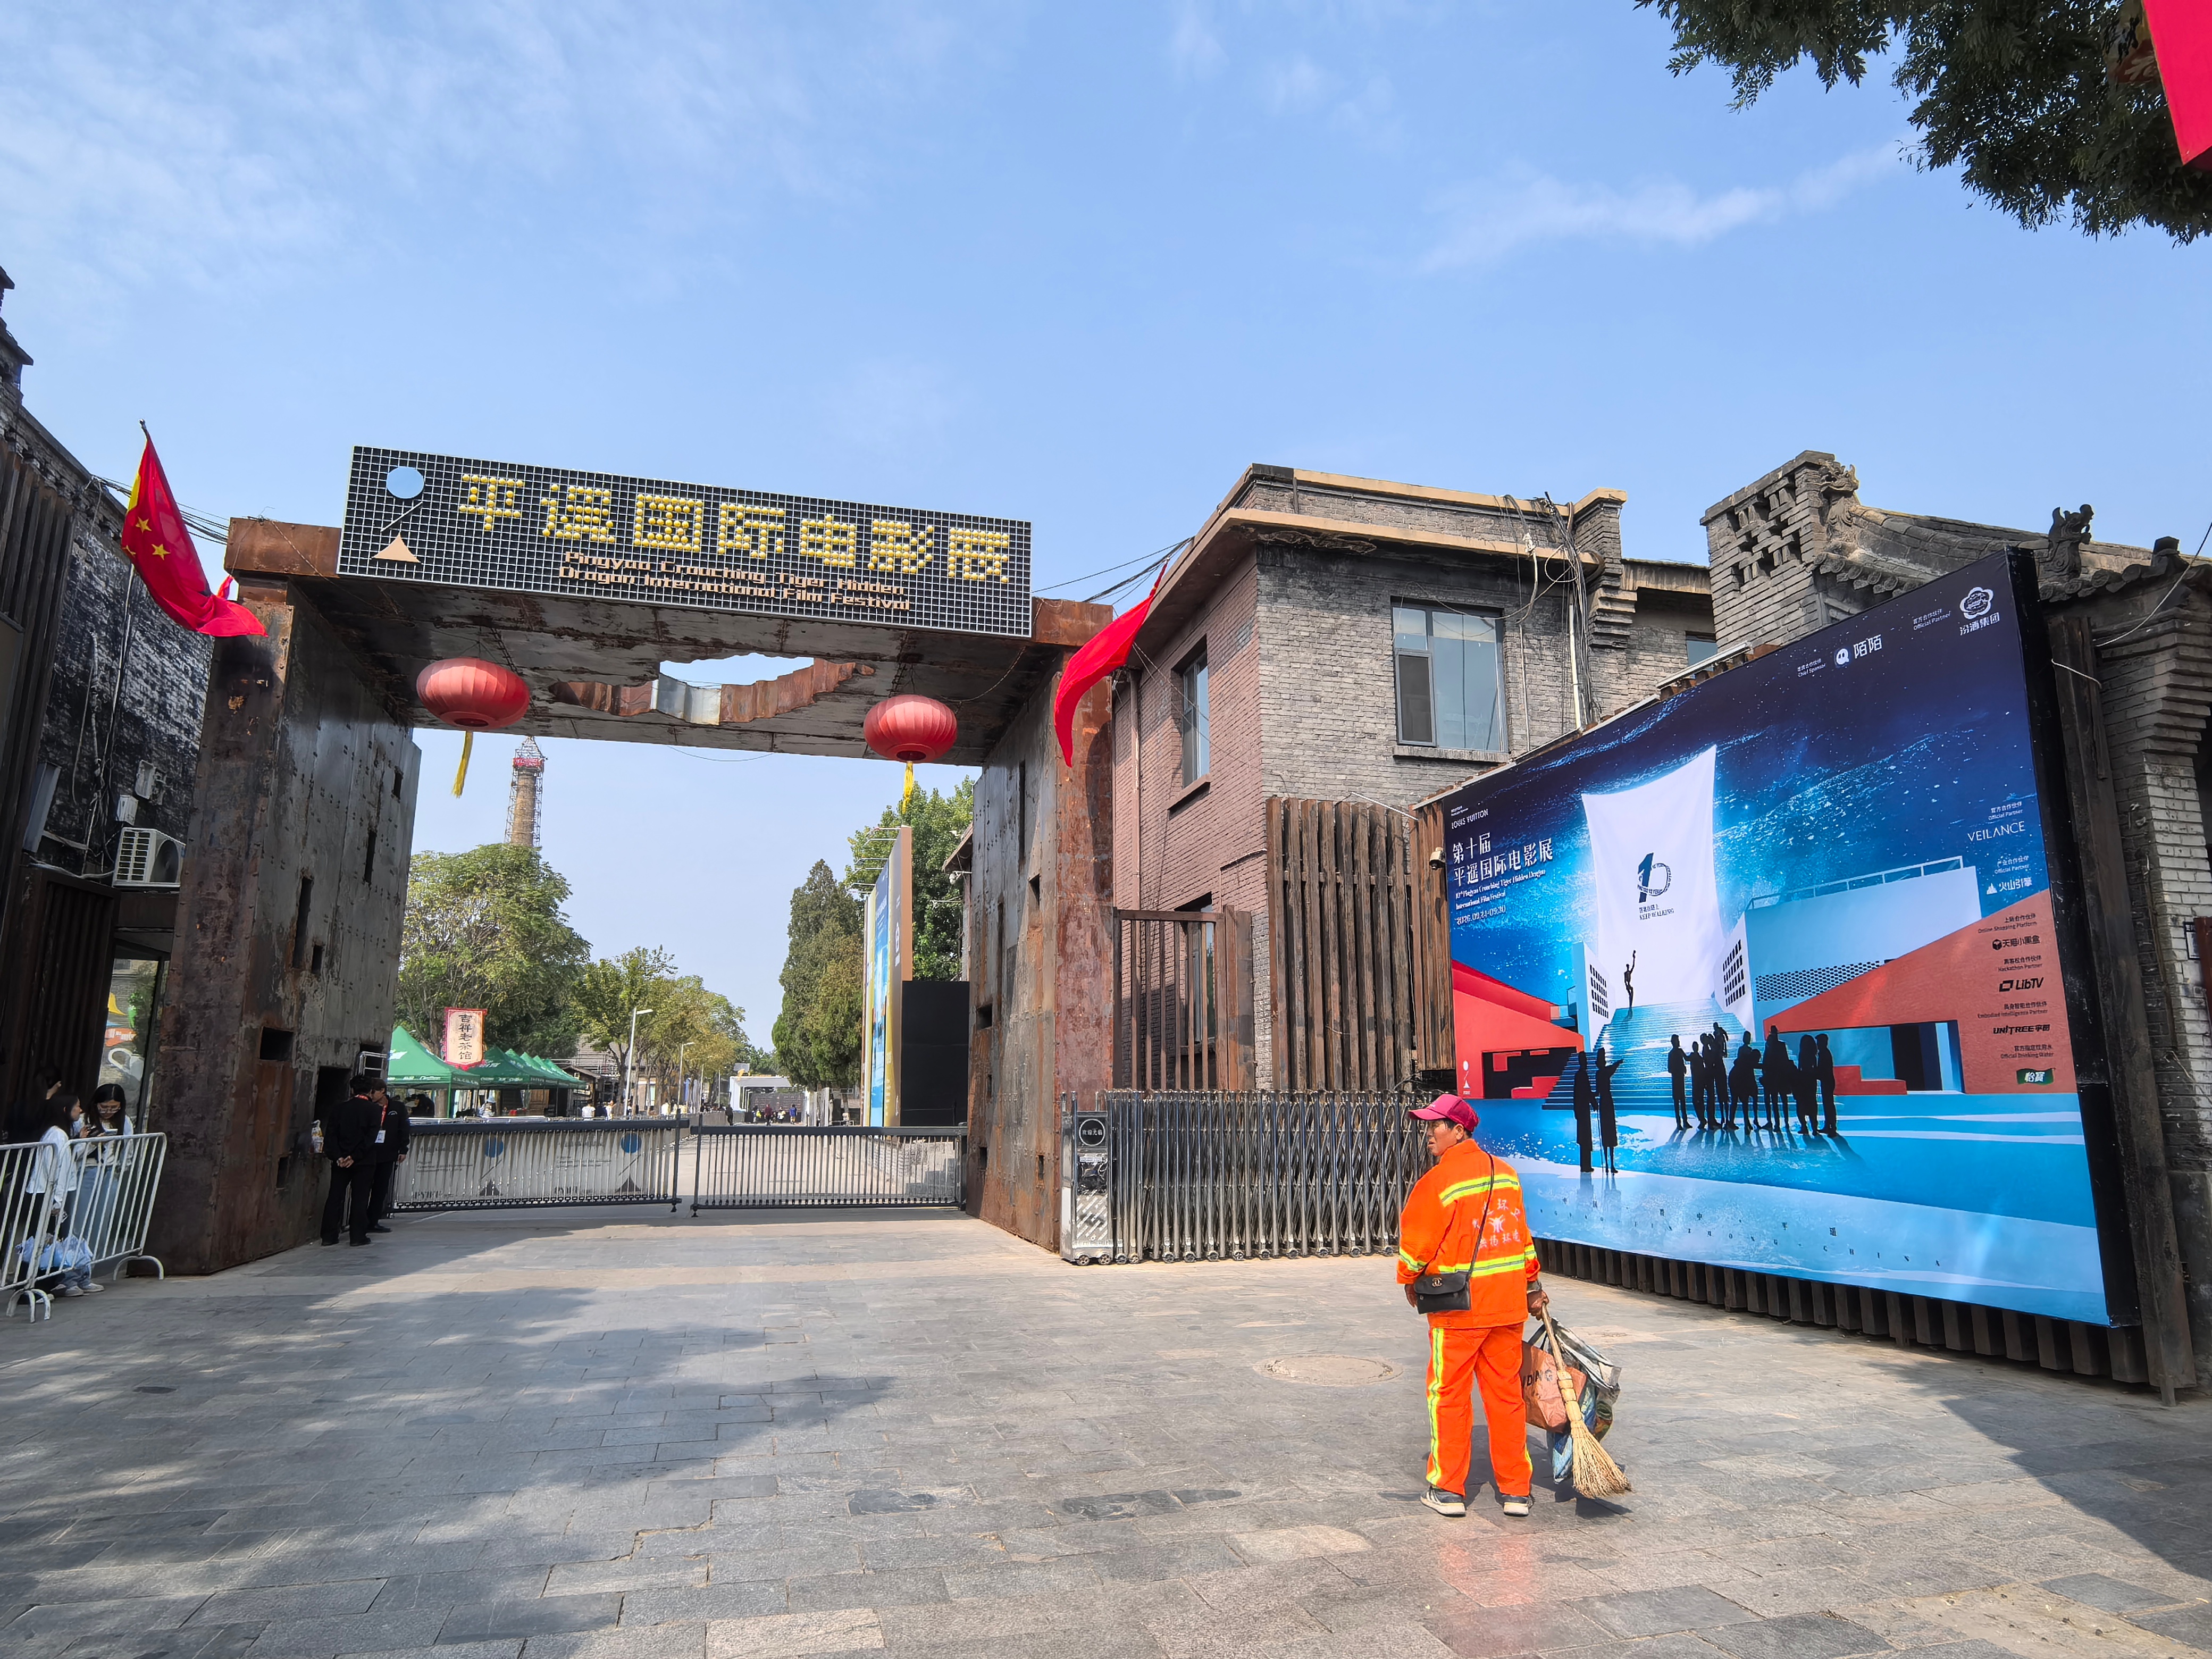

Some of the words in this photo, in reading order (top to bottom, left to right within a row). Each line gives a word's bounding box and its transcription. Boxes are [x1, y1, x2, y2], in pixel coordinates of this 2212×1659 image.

[459, 473, 1010, 584] 平遥国际电影展
[559, 566, 635, 584] Dragon
[644, 574, 775, 598] International
[783, 587, 823, 602] Film
[831, 592, 909, 611] Festival
[661, 560, 765, 584] Crouching
[775, 572, 825, 588] Tiger
[839, 579, 904, 595] Hidden
[1853, 634, 1882, 659] 陌陌
[1451, 817, 1465, 829] LOUIS
[1467, 808, 1488, 823] VUITTON
[1967, 821, 2025, 841] VEILANCE
[1452, 832, 1491, 864] 第十届
[1453, 837, 1553, 887] 平遥国际电影展
[1999, 877, 2032, 892] 火山引擎
[2015, 977, 2044, 990] LibTV
[1993, 1025, 2034, 1035] UNITREE
